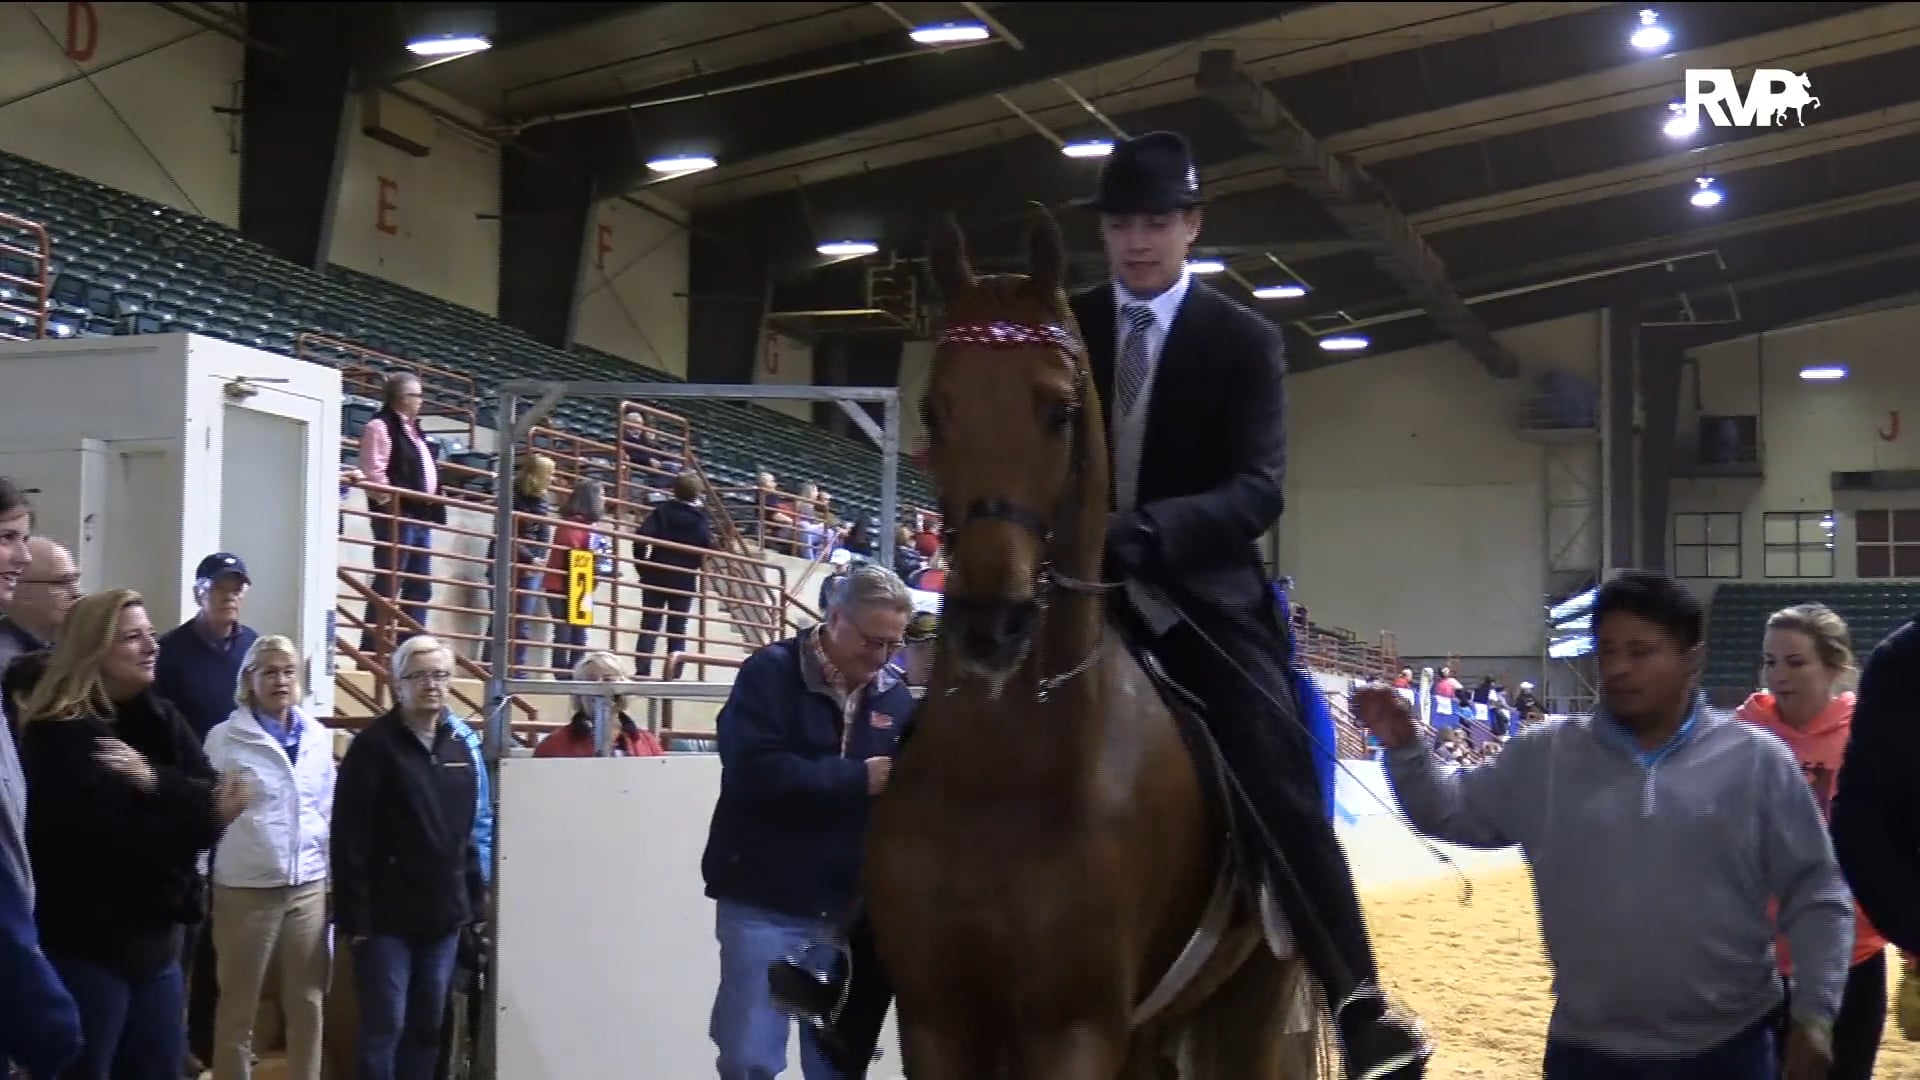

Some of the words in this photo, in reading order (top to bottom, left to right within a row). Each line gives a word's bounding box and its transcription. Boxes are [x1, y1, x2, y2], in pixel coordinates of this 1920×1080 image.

[66, 2, 97, 62] D
[376, 175, 399, 235] E
[597, 224, 613, 270] F
[764, 333, 779, 375] G
[1878, 411, 1900, 442] J
[575, 572, 587, 619] 2
